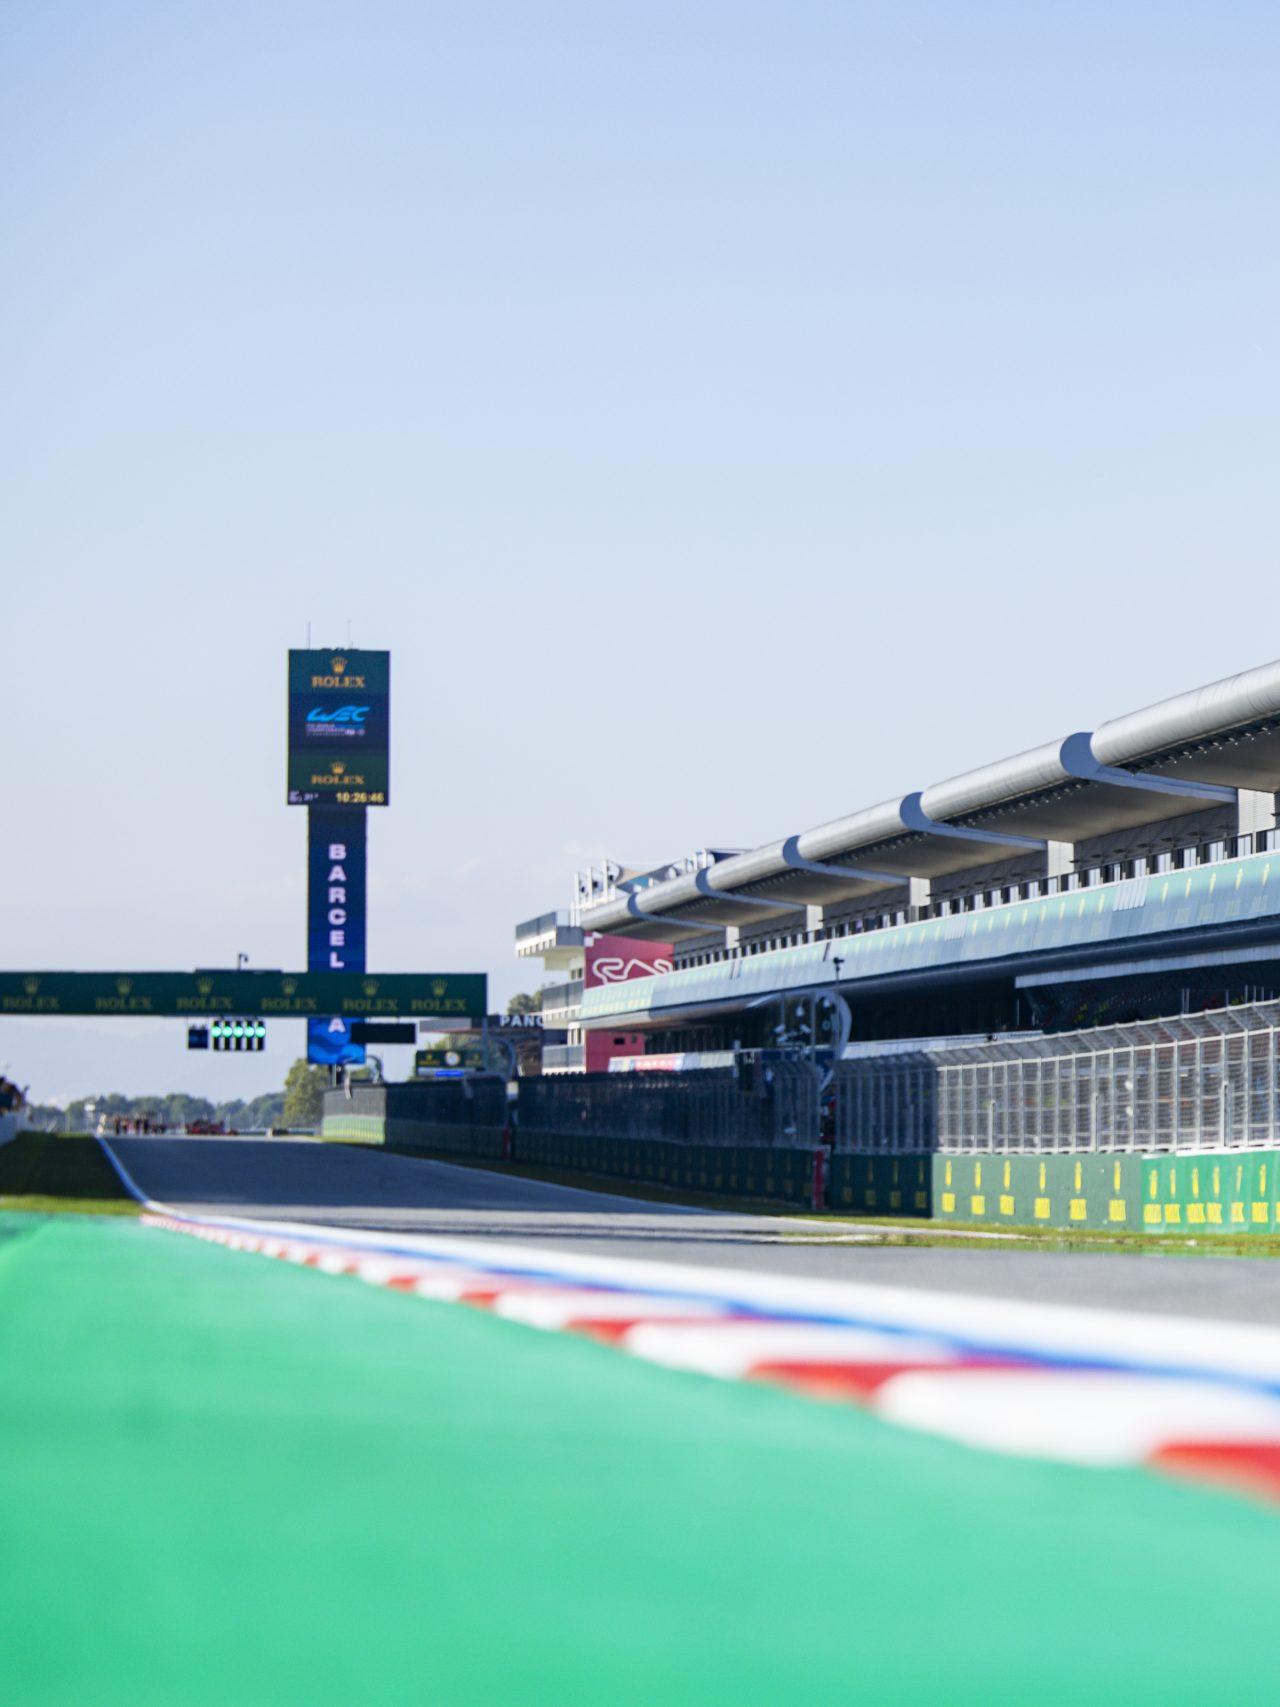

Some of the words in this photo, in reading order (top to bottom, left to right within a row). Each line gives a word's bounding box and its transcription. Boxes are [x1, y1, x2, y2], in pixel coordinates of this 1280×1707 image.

[311, 676, 365, 688] ROLEX
[307, 706, 370, 722] WEC
[311, 775, 365, 784] ROLEX
[328, 843, 347, 1033] BARCELA
